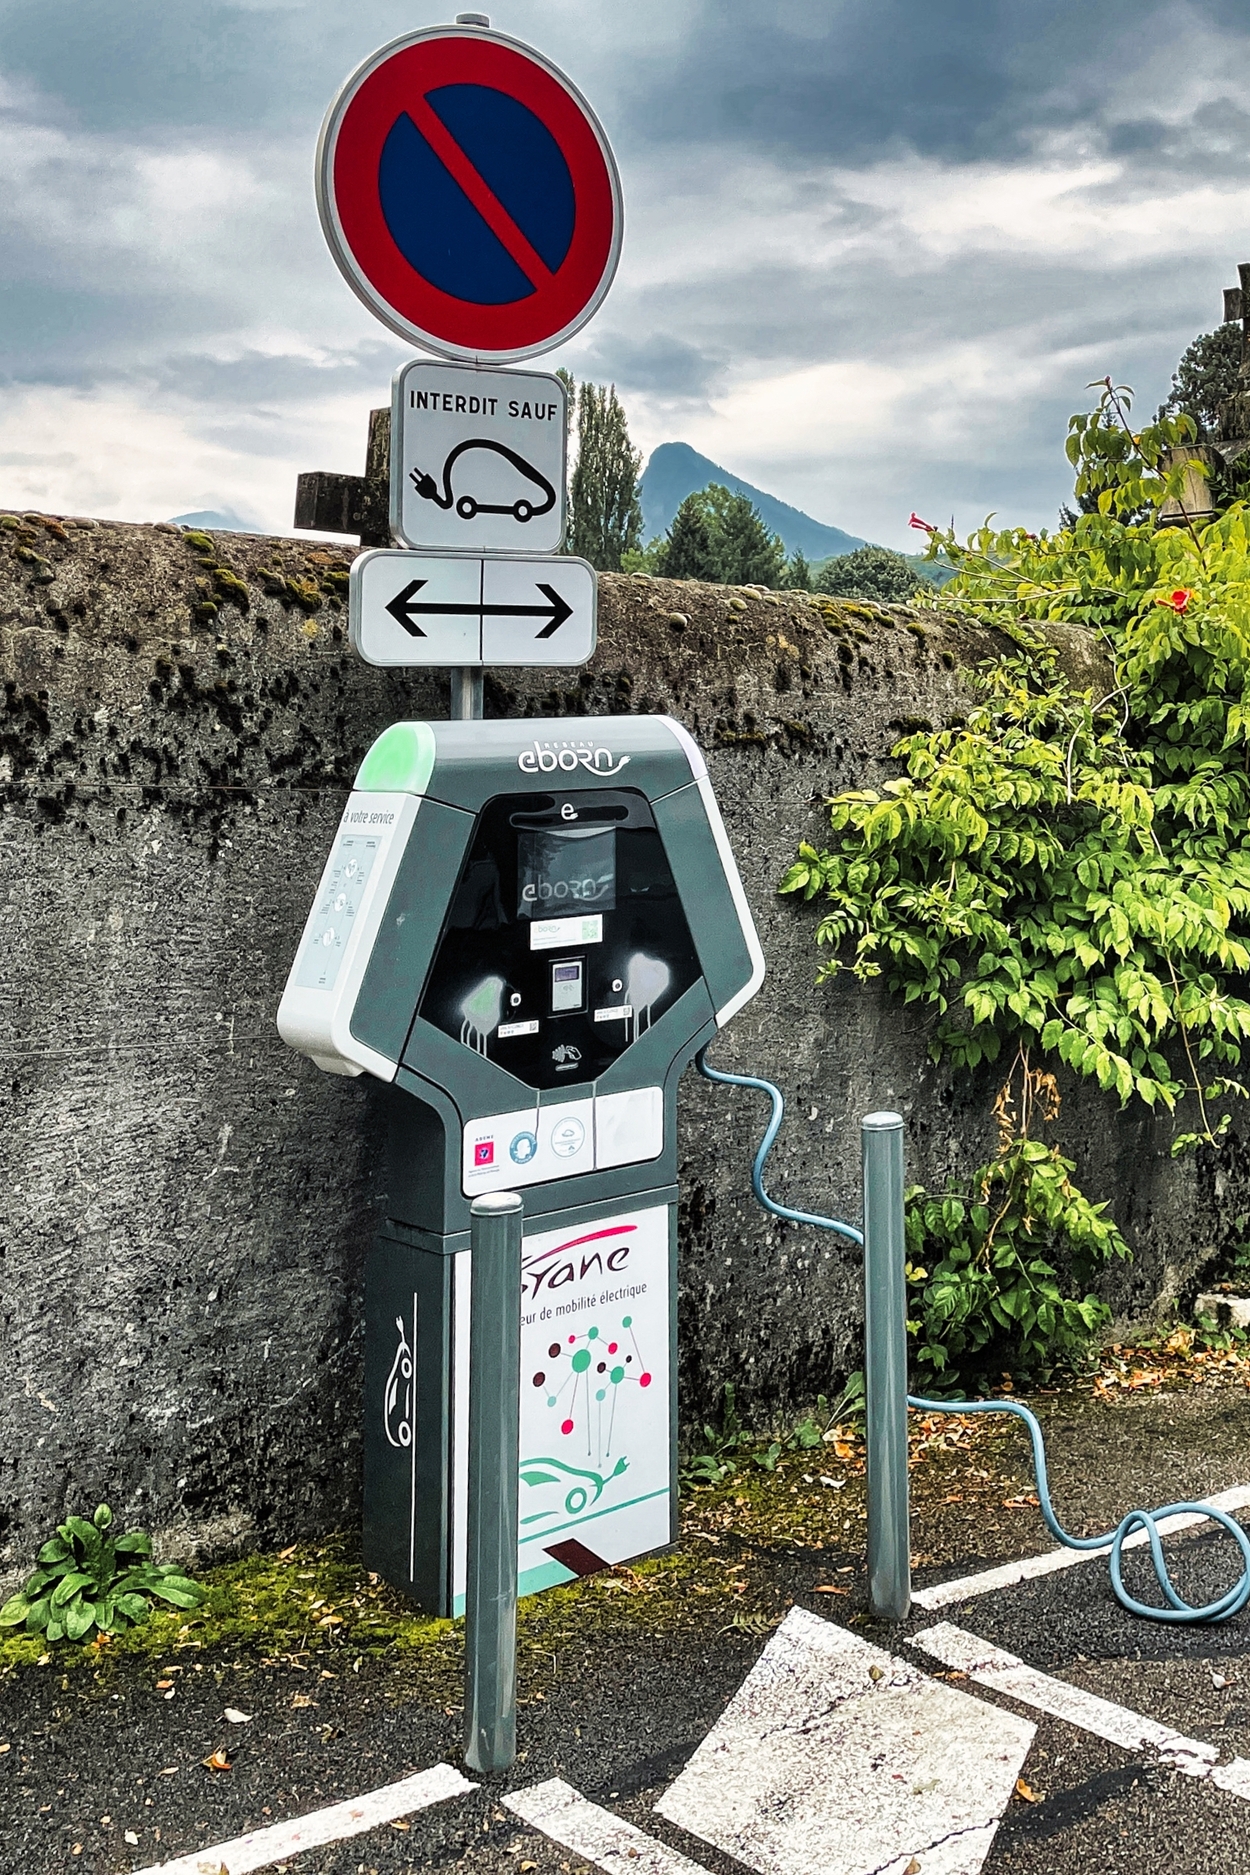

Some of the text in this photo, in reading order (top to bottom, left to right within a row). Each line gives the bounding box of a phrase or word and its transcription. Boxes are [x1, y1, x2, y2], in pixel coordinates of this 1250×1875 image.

[410, 390, 557, 421] INTERDIT SAUF
[350, 810, 368, 823] votre
[369, 810, 395, 825] service
[540, 1306, 552, 1321] de
[555, 1293, 597, 1317] mobilité
[599, 1283, 648, 1305] électrique
